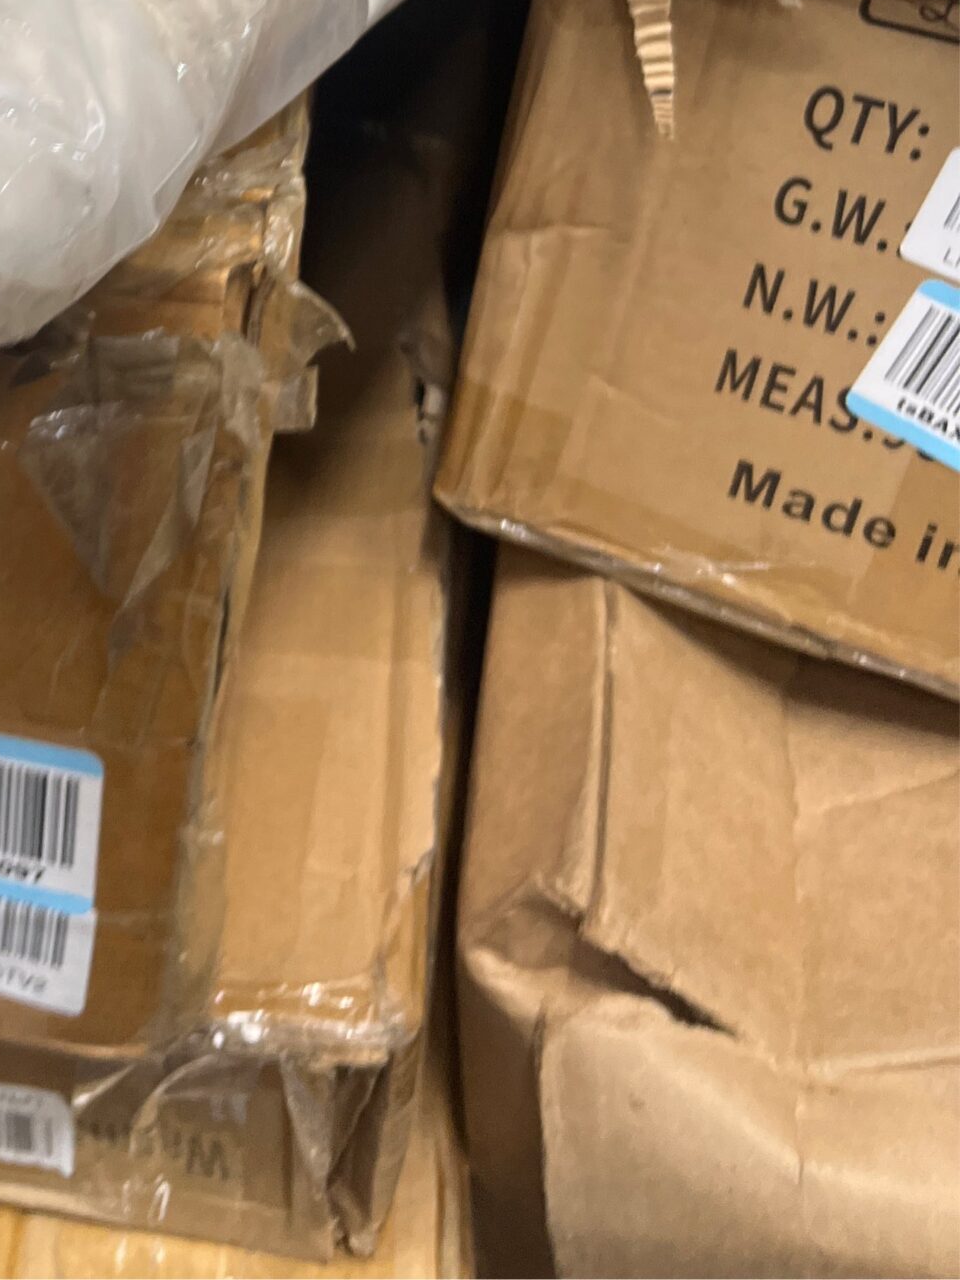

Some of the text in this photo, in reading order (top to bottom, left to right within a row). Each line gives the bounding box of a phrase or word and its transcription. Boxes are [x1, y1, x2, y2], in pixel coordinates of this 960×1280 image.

[802, 85, 931, 162] QTY:
[742, 262, 886, 347] N.W.:
[727, 458, 897, 550] Made
